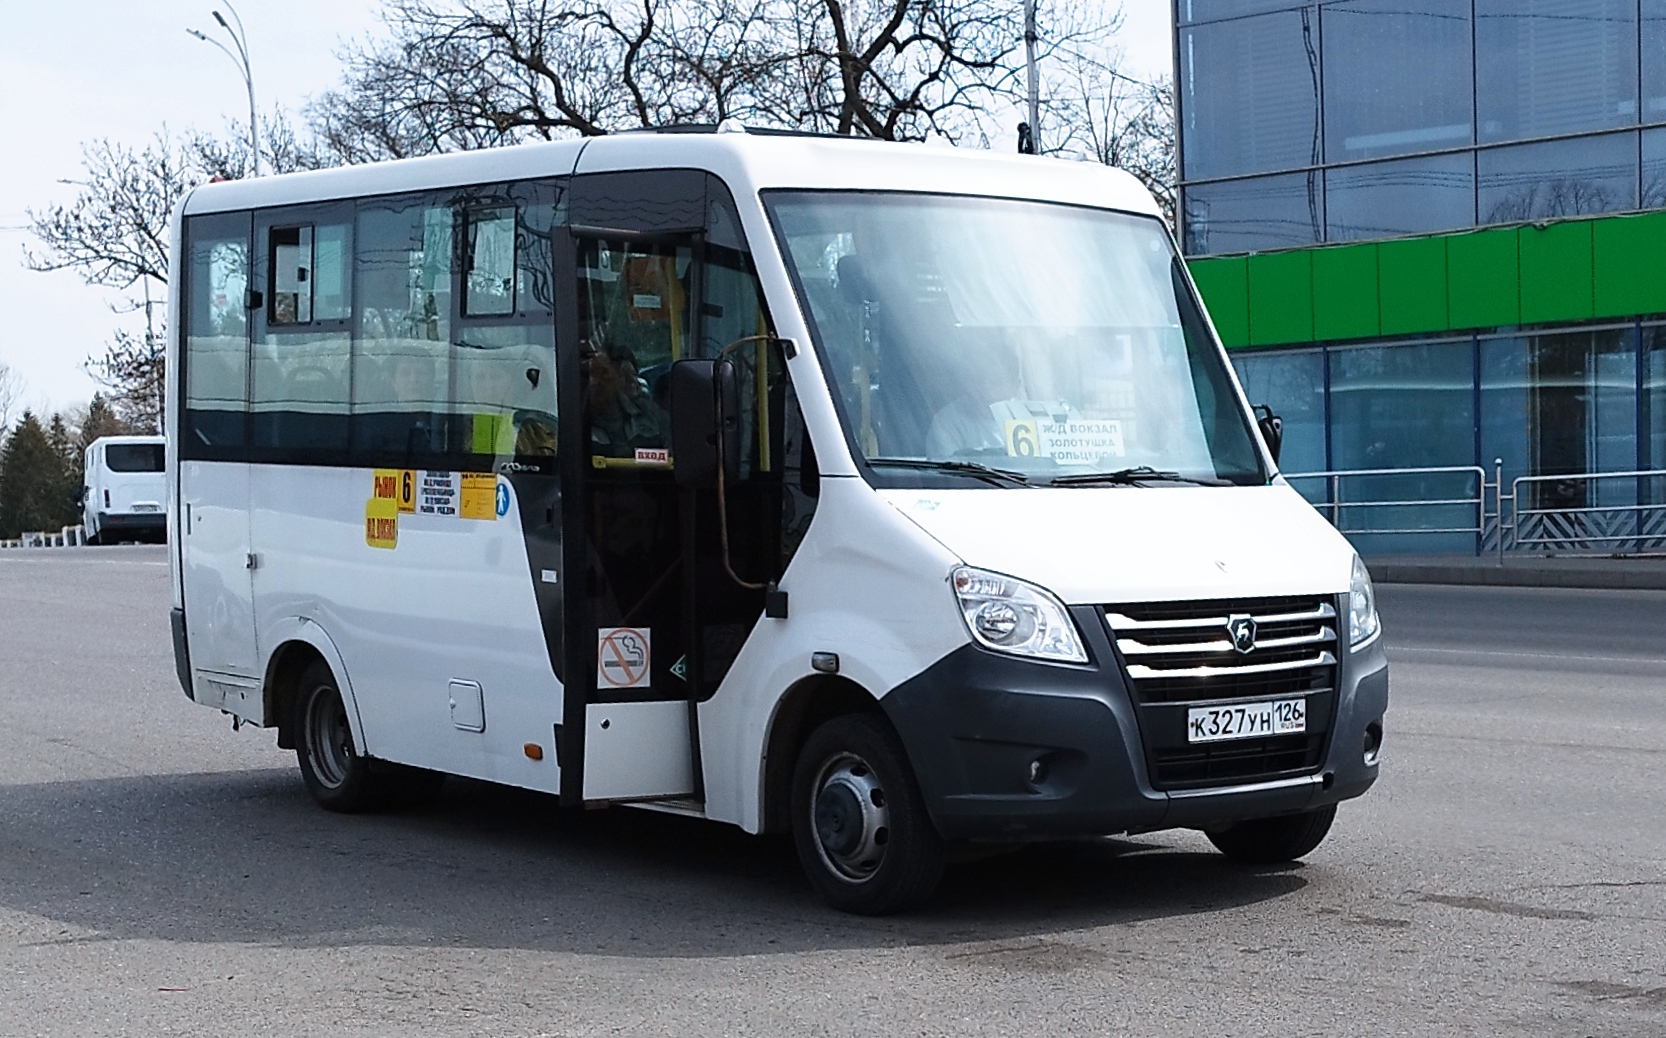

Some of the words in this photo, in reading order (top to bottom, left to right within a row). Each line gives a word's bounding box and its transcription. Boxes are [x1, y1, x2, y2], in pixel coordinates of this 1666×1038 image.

[1012, 423, 1035, 456] 6
[1070, 424, 1117, 434] ВОКЗАЛ
[1048, 438, 1115, 448] ЗОЛОТУШКА
[637, 451, 666, 461] ВХОД
[402, 471, 411, 504] 6
[1195, 708, 1271, 737] К327УН
[1275, 702, 1301, 722] 126
[1280, 721, 1294, 729] RUS
